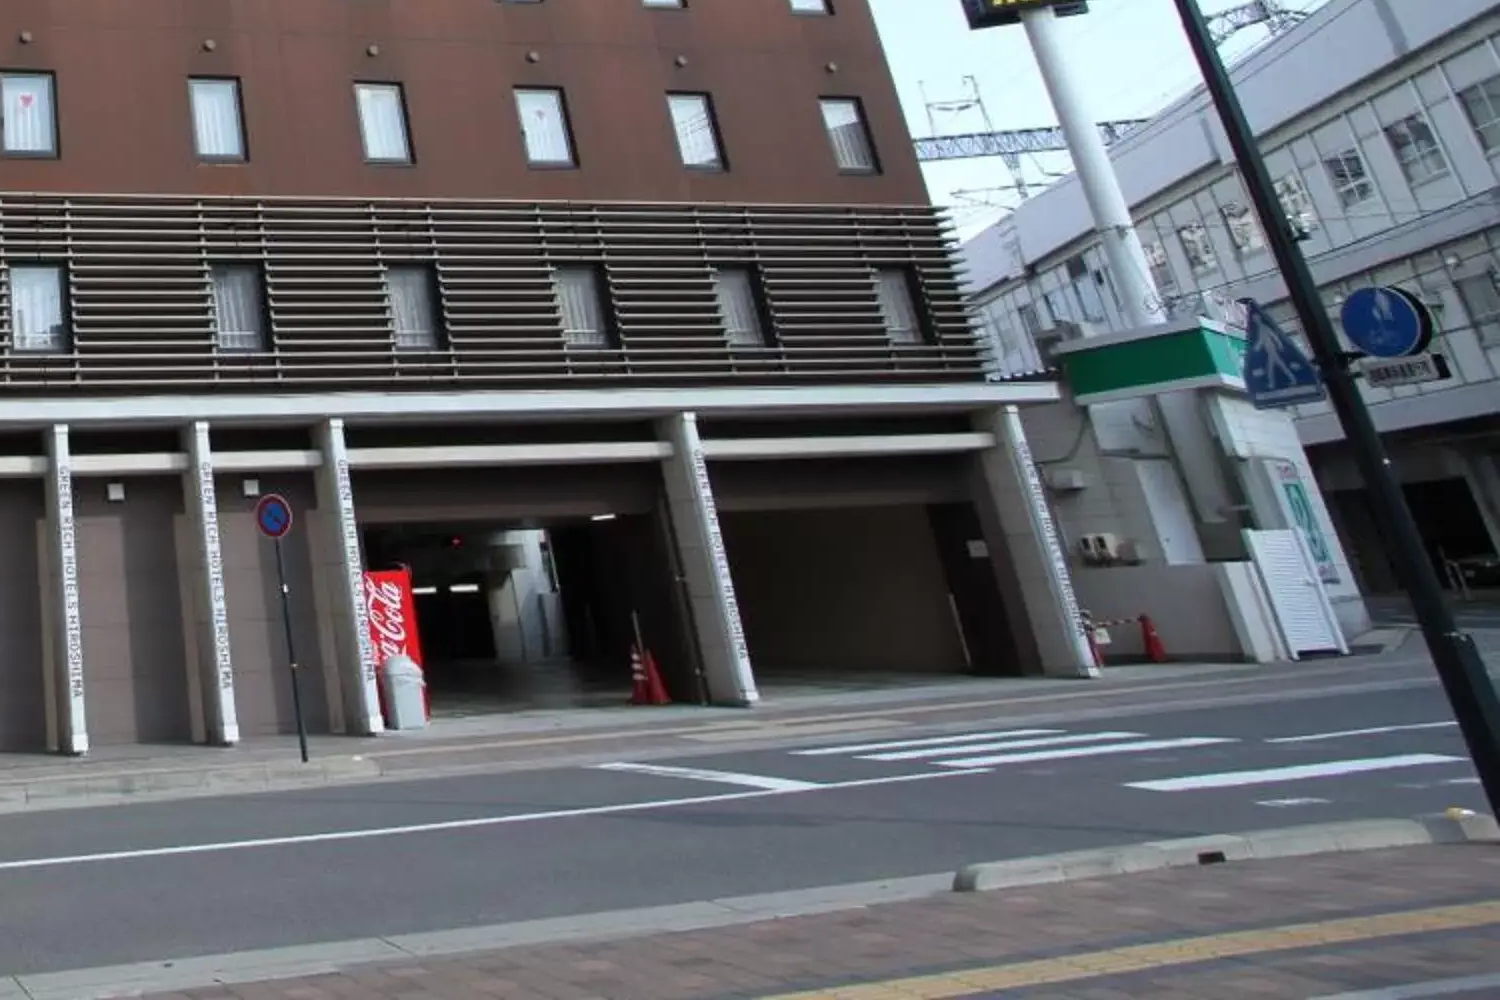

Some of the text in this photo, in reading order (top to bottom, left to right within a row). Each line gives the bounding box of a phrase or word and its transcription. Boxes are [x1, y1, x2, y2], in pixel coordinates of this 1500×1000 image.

[210, 550, 226, 604] HOTELS
[68, 615, 84, 698] HIROSHIMA
[216, 607, 232, 690] HIROSHIMA
